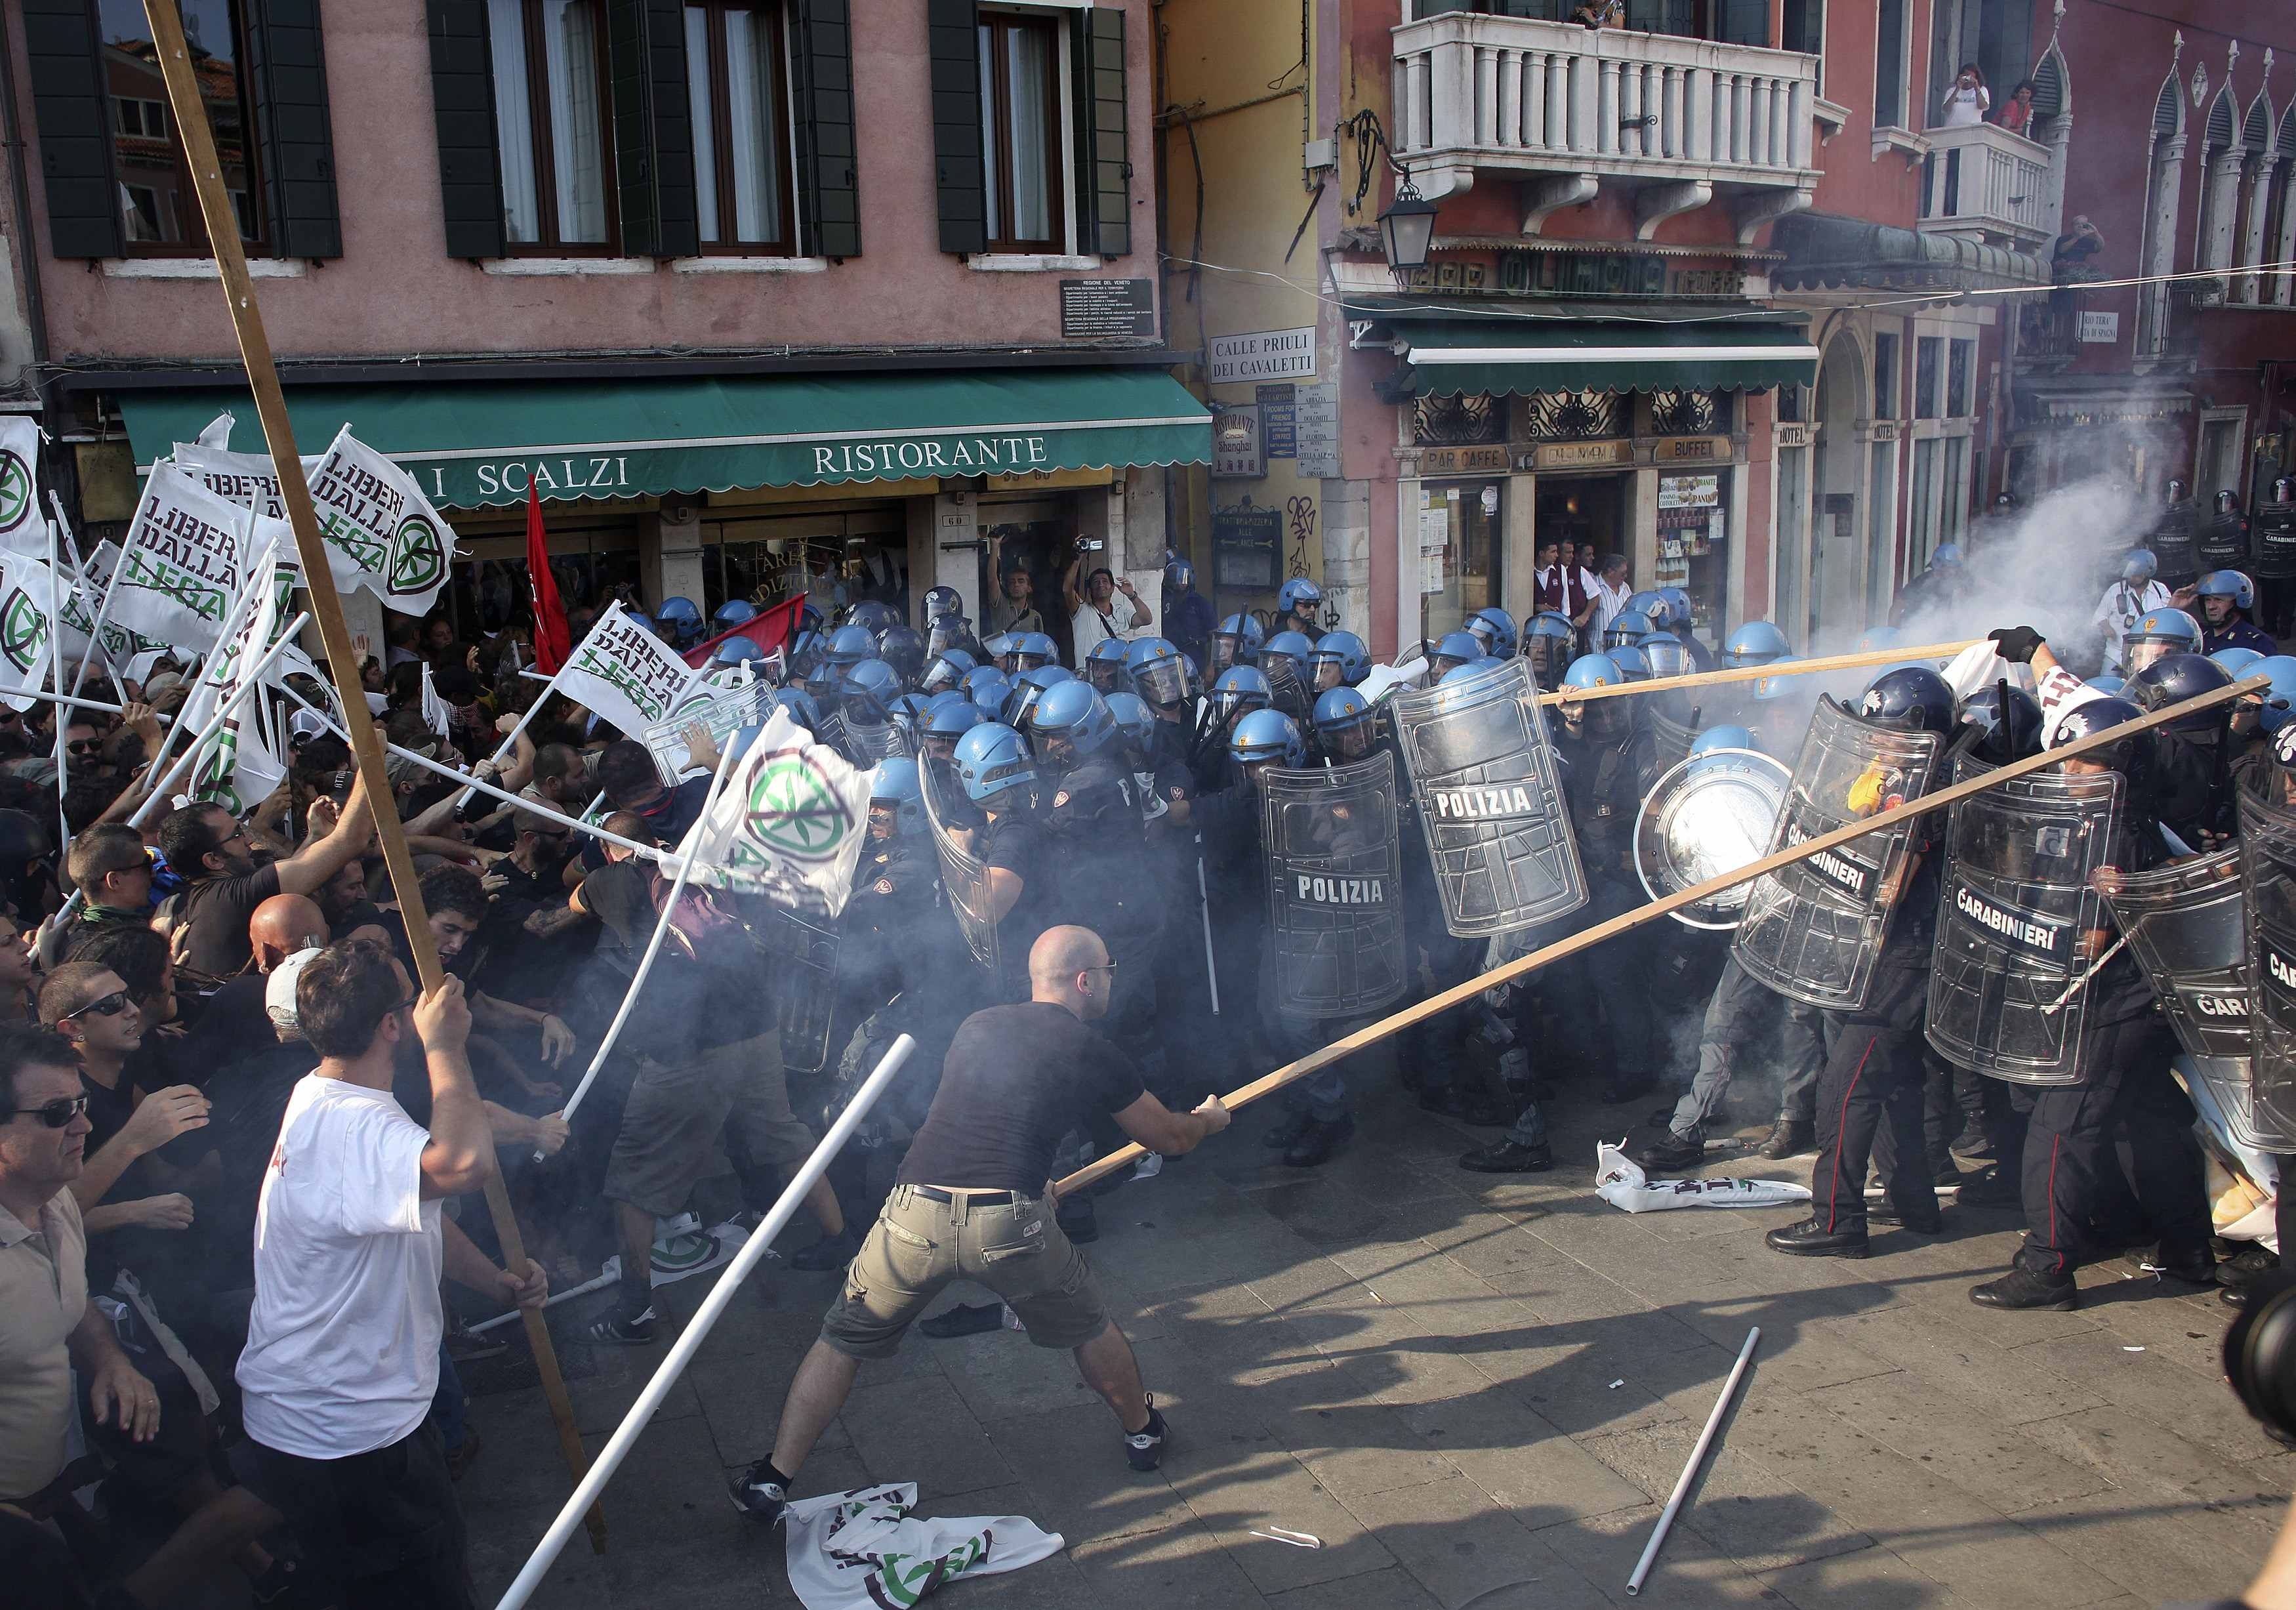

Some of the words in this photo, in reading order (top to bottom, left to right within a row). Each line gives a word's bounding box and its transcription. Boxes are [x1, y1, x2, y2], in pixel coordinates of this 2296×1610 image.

[1216, 340, 1257, 357] CALLE
[1263, 334, 1307, 352] PRIULI
[1214, 362, 1234, 377] DEI
[1240, 355, 1312, 375] CAVALETTI
[1213, 414, 1256, 437] RISTORANTE
[1780, 426, 1805, 444] HOTEL
[1874, 424, 1895, 440] HOTEL
[811, 436, 1048, 474] RISTORANTE
[1218, 440, 1252, 454] Shanghai
[1675, 440, 1714, 457] BUFFET
[477, 457, 630, 495] SCALZI
[312, 476, 396, 544] DALLA
[311, 499, 388, 573] EGA
[2266, 535, 2296, 543] CARABINIE
[136, 522, 237, 591] DALLA
[125, 549, 226, 622] LEGA
[578, 648, 663, 721] LEGA
[592, 632, 673, 711] DALLA
[1437, 787, 1532, 819] POLIZIA
[1788, 823, 1864, 890] CARBINIERI
[1298, 874, 1383, 904] POLIZIA
[1957, 889, 2055, 951] CARABINIERI
